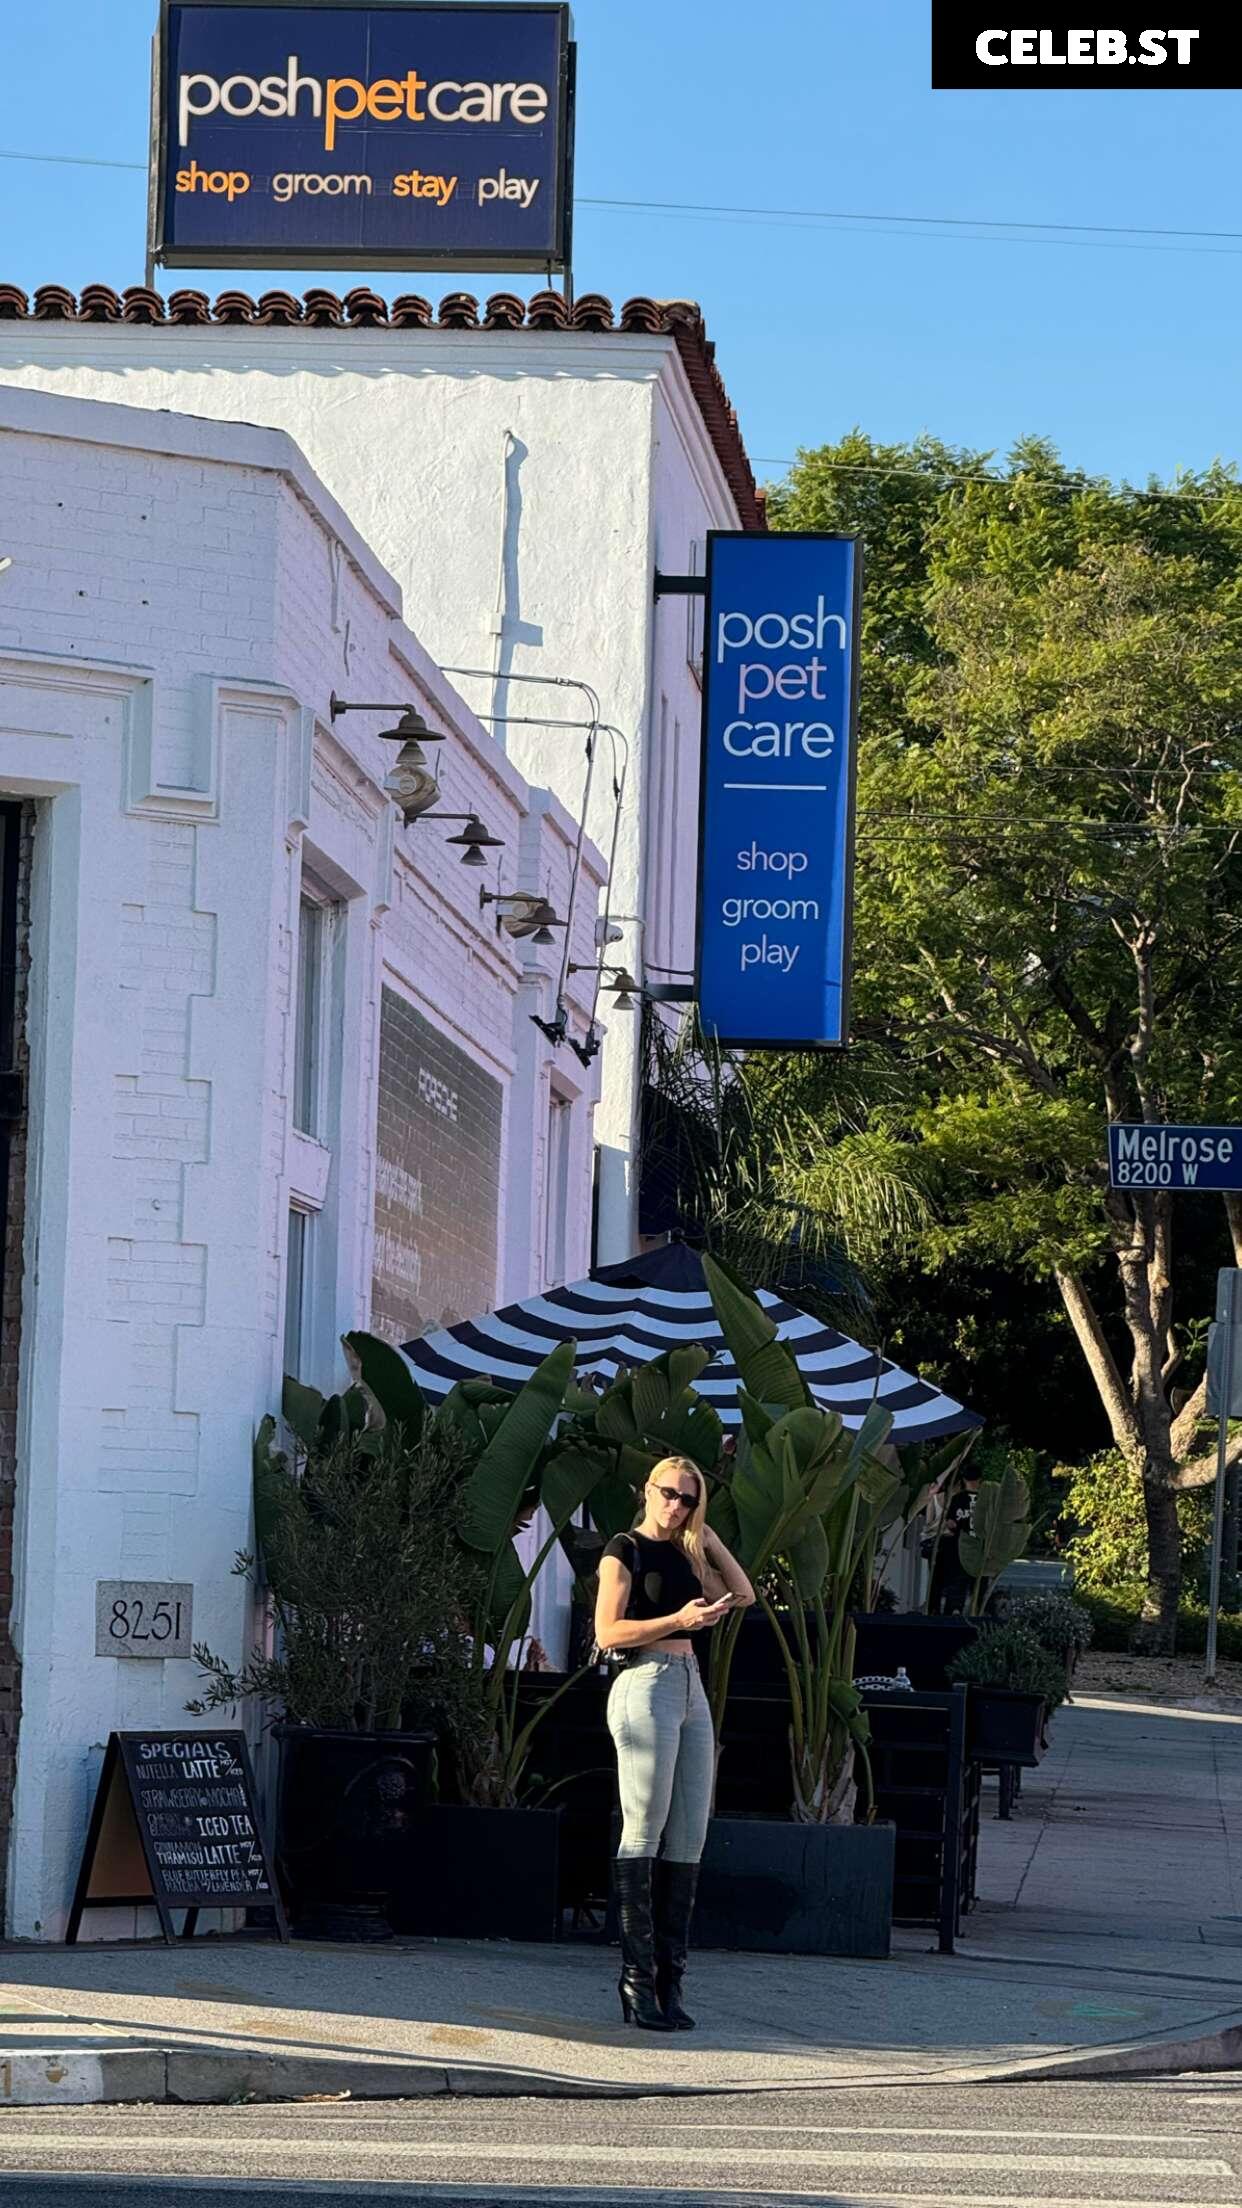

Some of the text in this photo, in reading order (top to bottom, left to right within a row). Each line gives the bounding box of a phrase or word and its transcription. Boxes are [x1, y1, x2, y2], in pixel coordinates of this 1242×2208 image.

[175, 160, 539, 208] shop groom stay play
[717, 595, 847, 663] posh
[738, 656, 827, 714] pet
[723, 720, 835, 759] care
[736, 840, 808, 881] shop
[722, 898, 819, 927] groom
[740, 933, 800, 972] play
[1117, 1128, 1233, 1163] Melrose
[1117, 1161, 1199, 1185] 8200 W
[109, 1600, 182, 1640] 8251
[140, 1741, 231, 1759] SPECIALS
[136, 1763, 178, 1779] NUTELLA
[182, 1759, 221, 1779] LATTE
[196, 1814, 255, 1836] ICED TEA
[157, 1850, 204, 1865] TIRAMISU
[203, 1844, 243, 1864] LATTE
[161, 1869, 183, 1881] BLUE
[184, 1869, 229, 1881] BUTTERFLY
